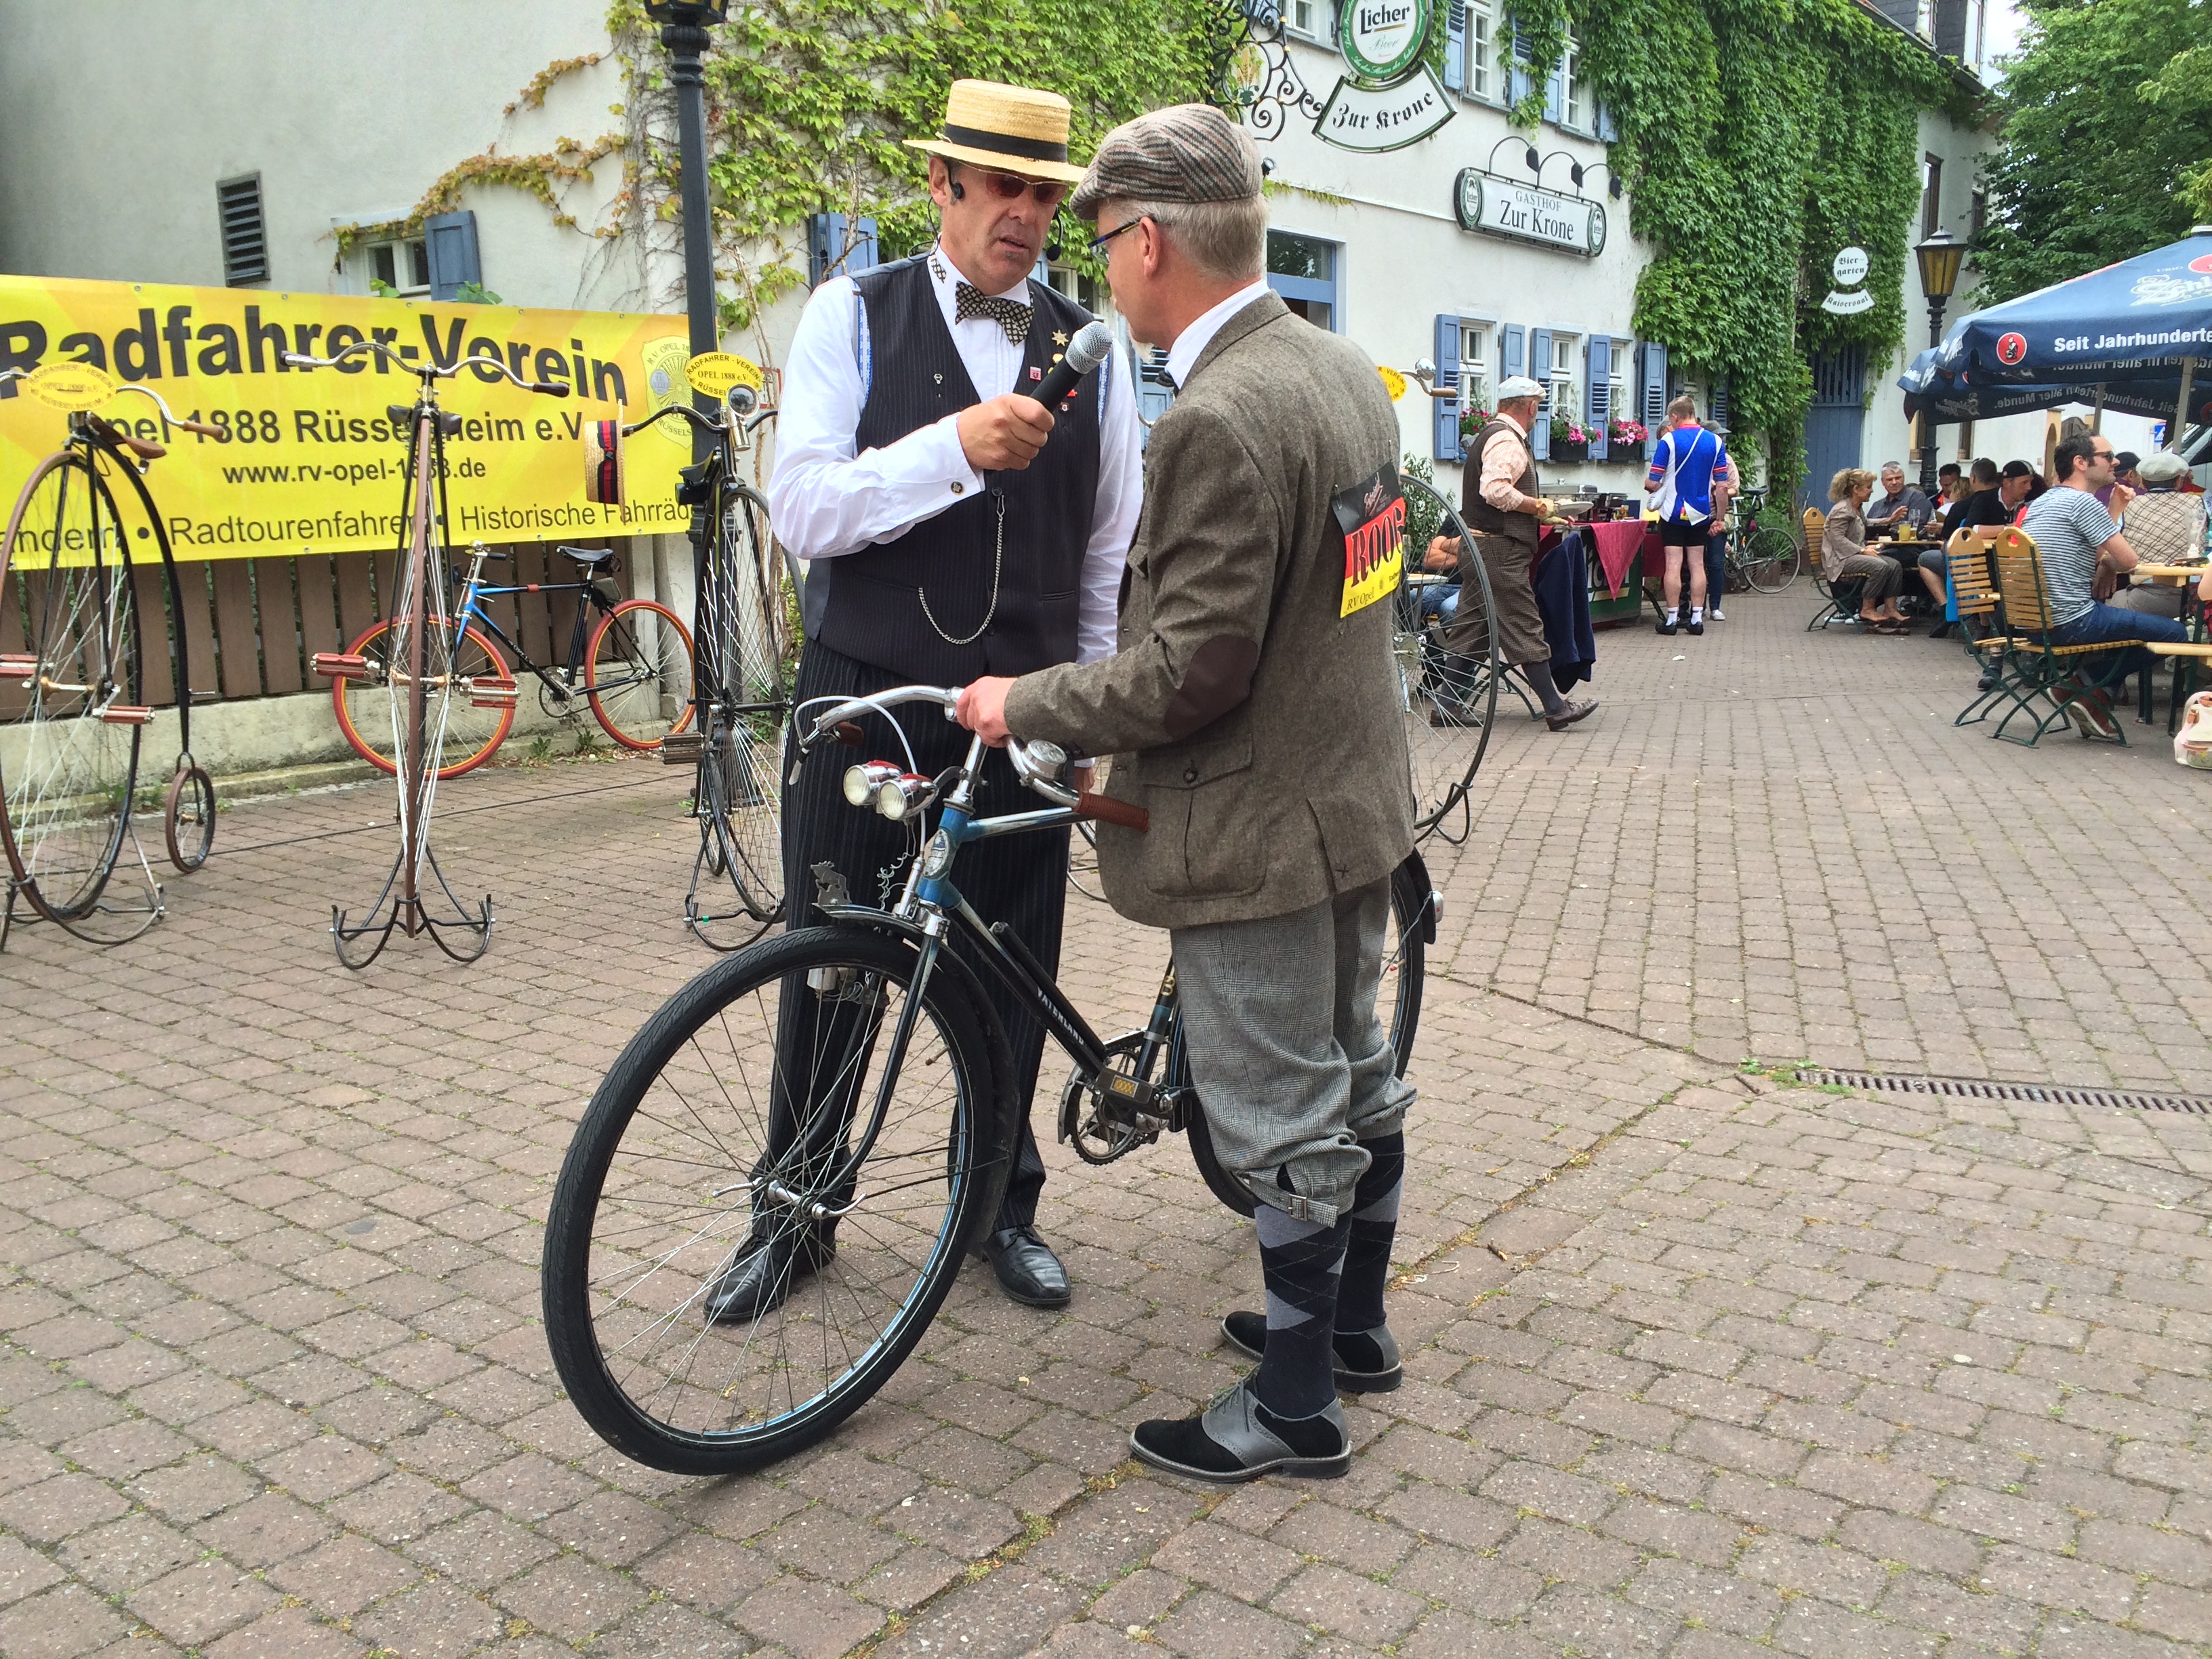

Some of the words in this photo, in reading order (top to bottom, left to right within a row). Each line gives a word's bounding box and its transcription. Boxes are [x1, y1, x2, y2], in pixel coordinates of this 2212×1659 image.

[1359, 3, 1410, 35] Licher
[1332, 102, 1370, 130] Zur
[1376, 92, 1434, 130] Krone
[1515, 190, 1562, 212] GASTHOF
[1499, 200, 1528, 230] Zur
[1532, 207, 1574, 241] Krone
[1837, 268, 1864, 278] garten
[0, 305, 628, 407] Radfahrer-Verein
[2054, 336, 2089, 352] Seit
[686, 354, 729, 375] RADFAHRER
[736, 358, 760, 381] VEREIN
[697, 370, 719, 380] OPEL
[720, 372, 736, 380] 1888
[186, 409, 281, 444] 1888
[460, 501, 596, 532] Historische
[1347, 595, 1360, 611] RV
[1359, 587, 1374, 605] Opel
[1036, 985, 1084, 1045] VATERLAND
